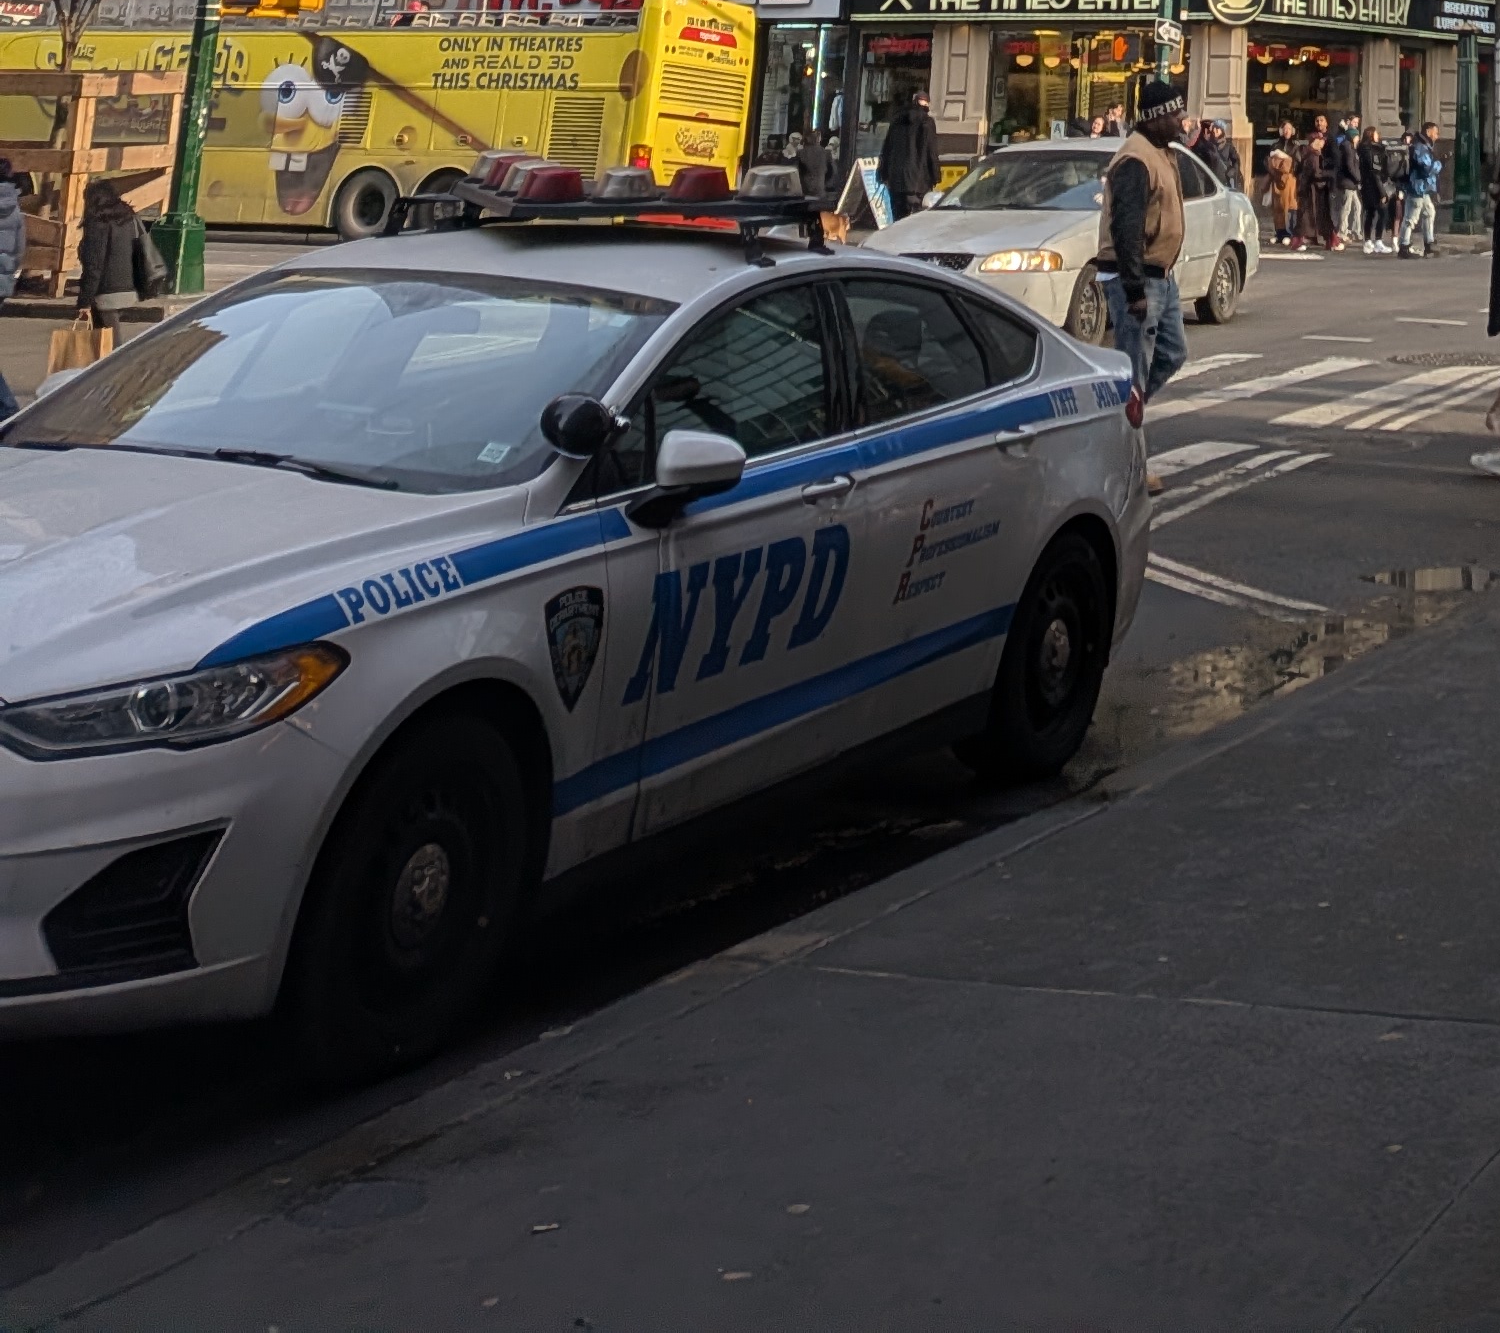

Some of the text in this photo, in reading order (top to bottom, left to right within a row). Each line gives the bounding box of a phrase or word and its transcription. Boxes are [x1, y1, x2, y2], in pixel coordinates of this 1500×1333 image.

[1443, 0, 1490, 18] BREAKFAST
[438, 37, 583, 52] ONLY IN THEATRES
[441, 58, 470, 70] AND
[547, 55, 575, 70] 3D
[432, 73, 580, 90] THIS CHRISTMAS
[338, 555, 461, 625] POLICE
[559, 590, 588, 609] POLICE
[621, 524, 851, 707] NYPD
